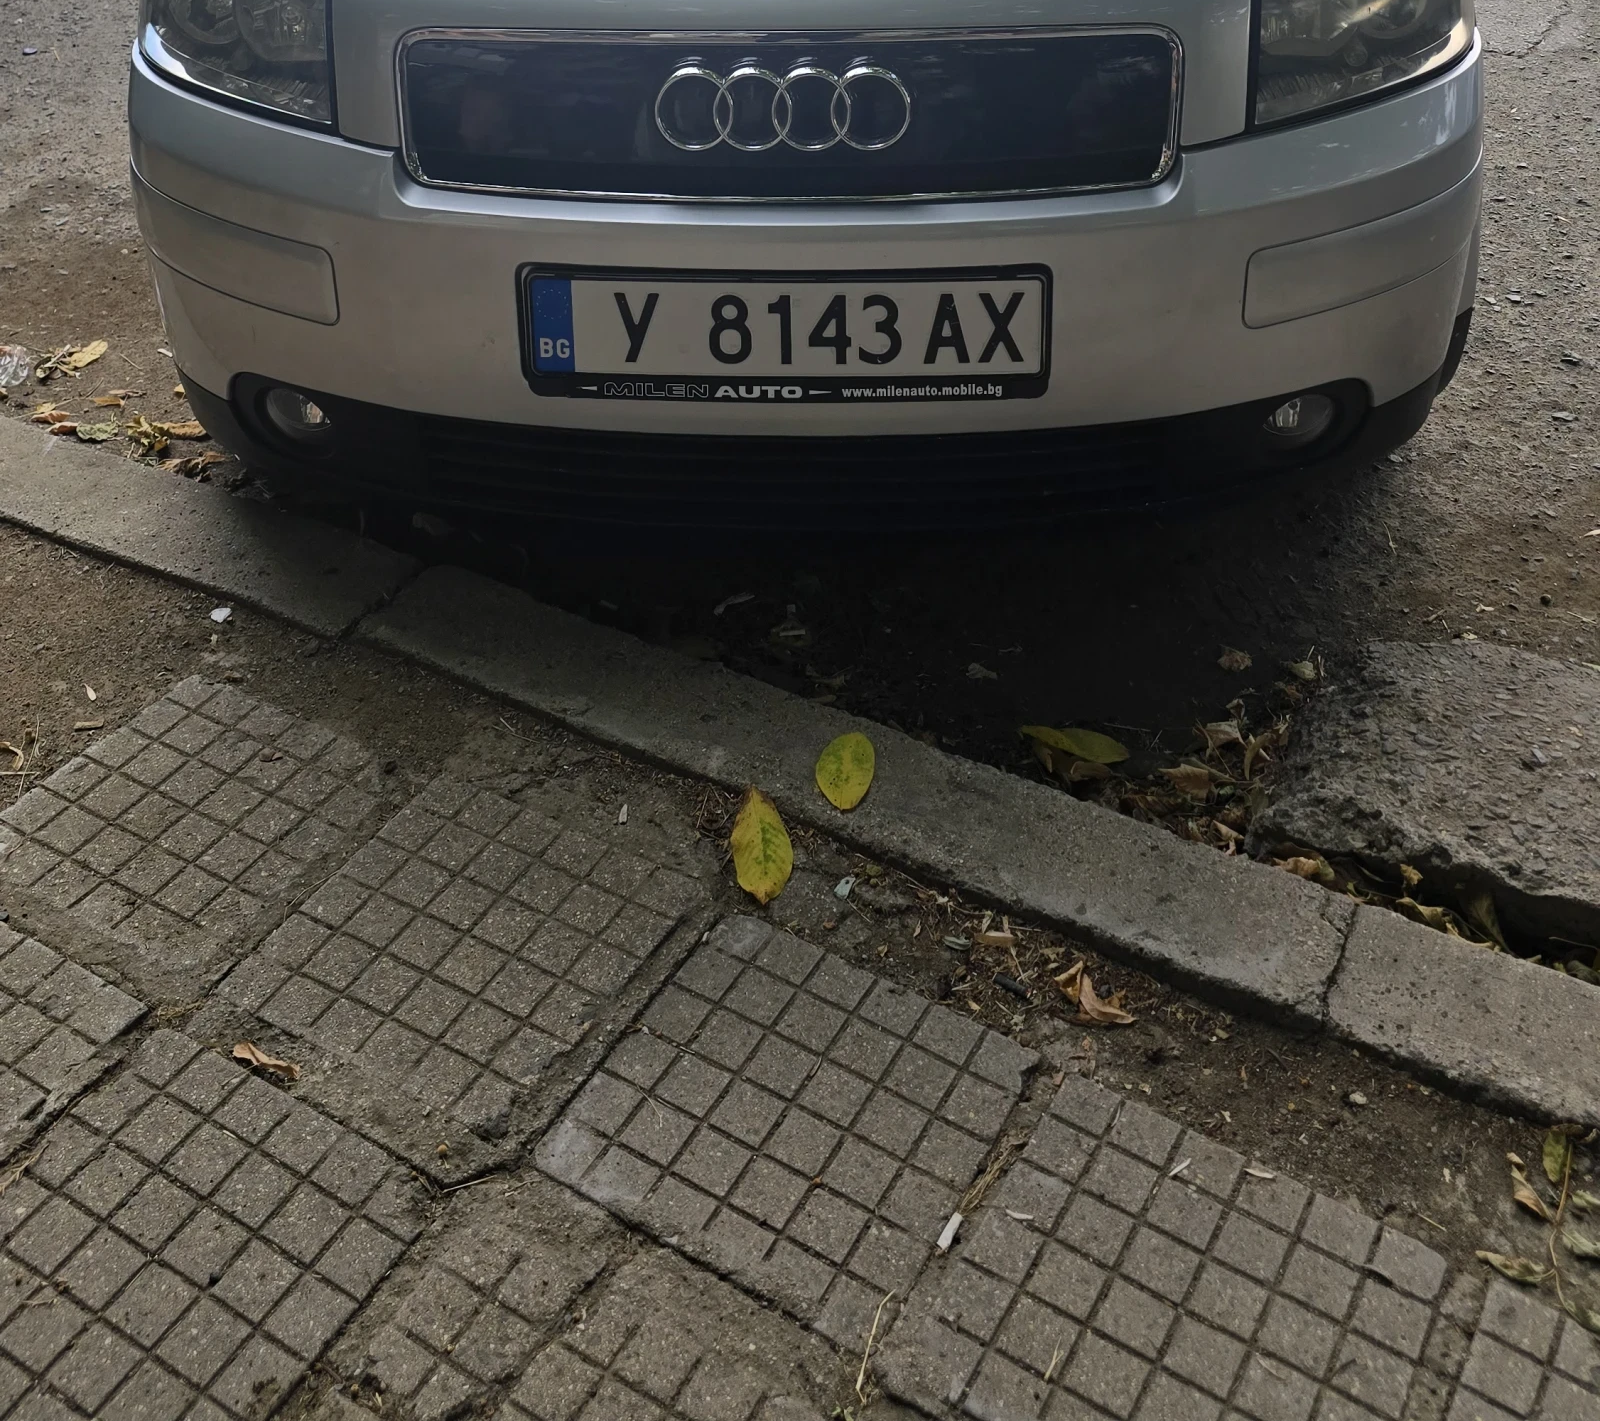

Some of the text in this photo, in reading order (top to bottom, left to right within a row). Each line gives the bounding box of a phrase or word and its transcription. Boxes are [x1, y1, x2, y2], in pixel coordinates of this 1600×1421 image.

[708, 293, 902, 365] 8143
[539, 337, 571, 359] BG
[603, 381, 1003, 398] MILEN AUTO www.milenauto.mobile.bg
